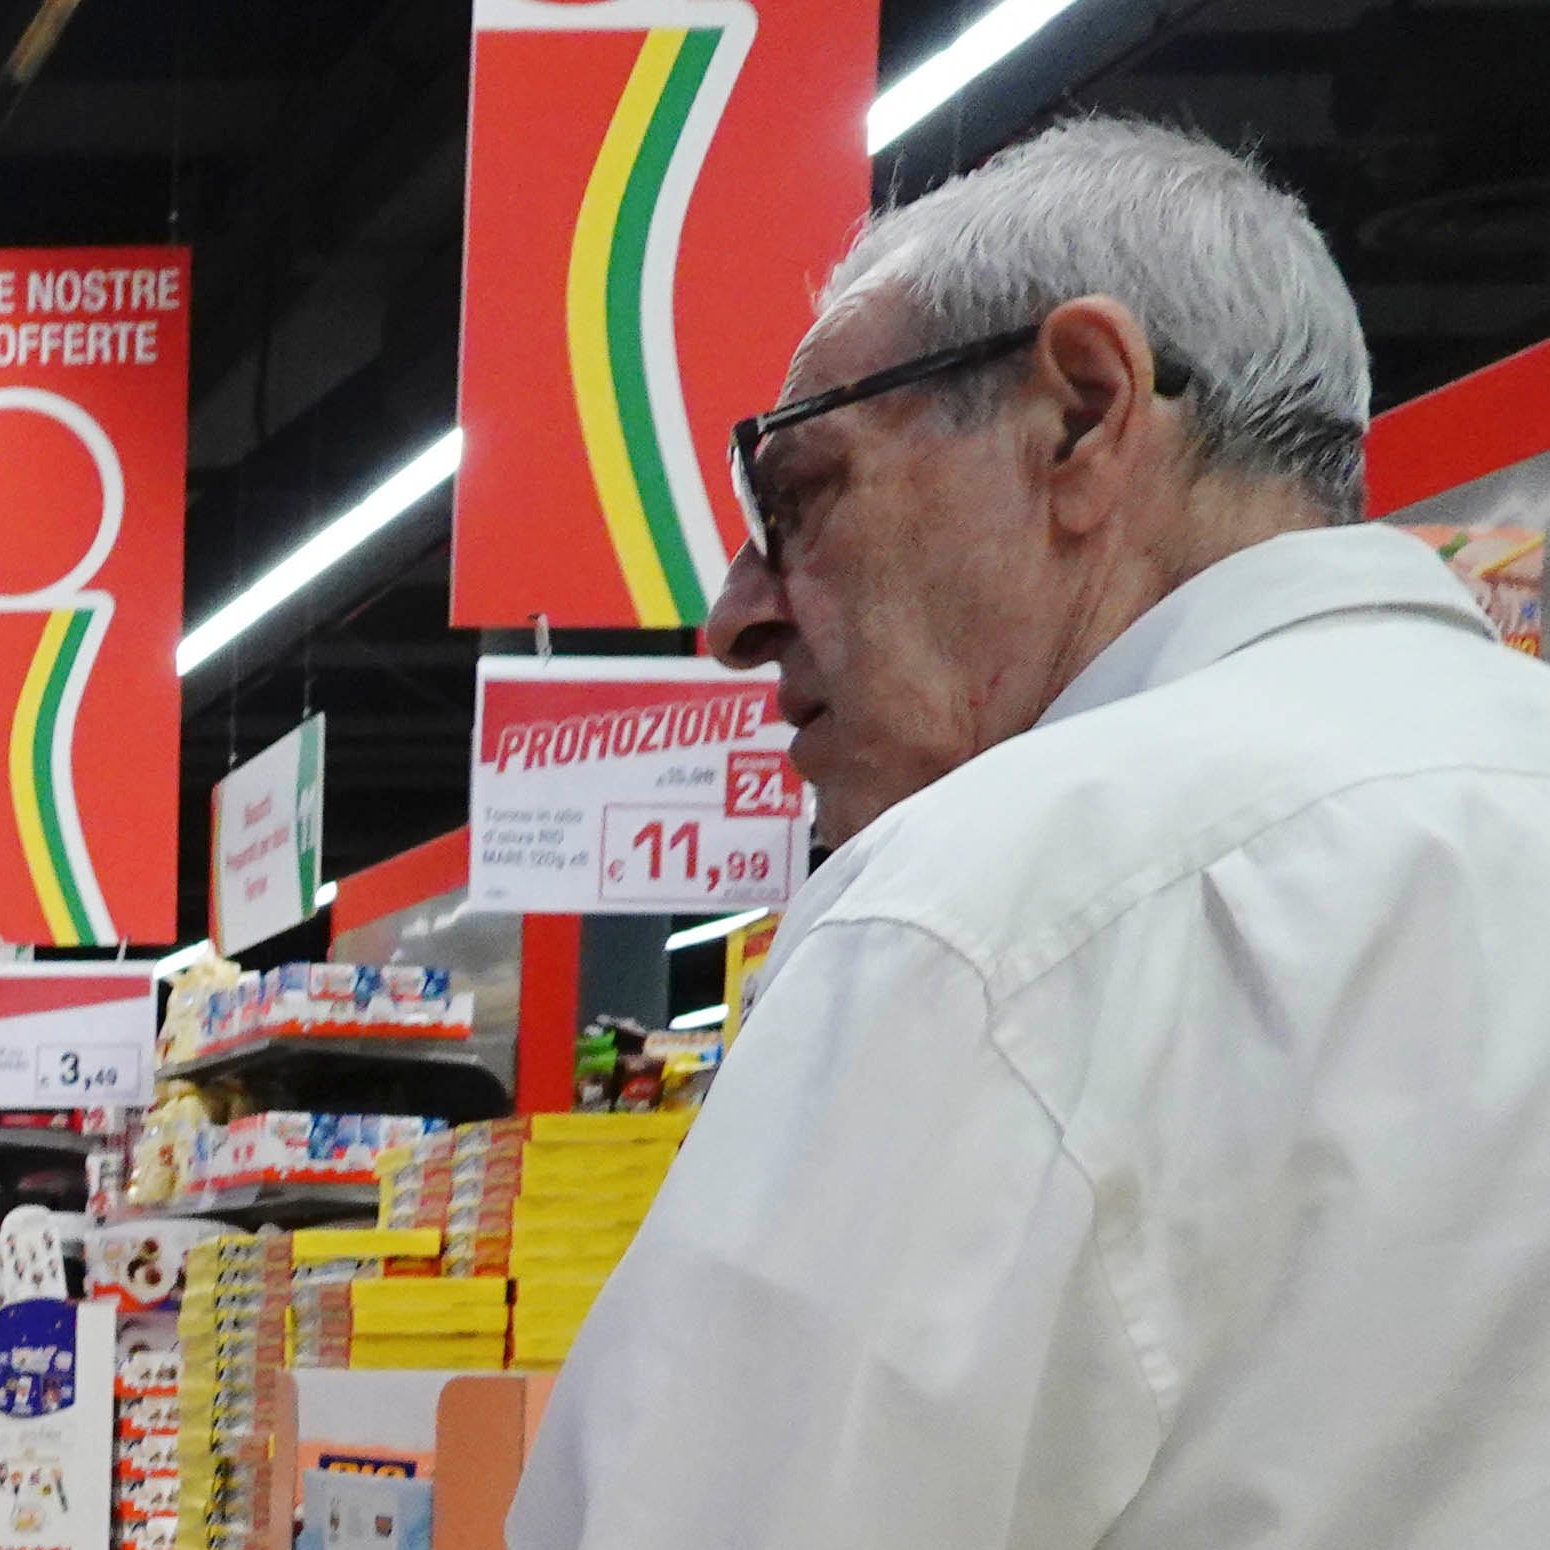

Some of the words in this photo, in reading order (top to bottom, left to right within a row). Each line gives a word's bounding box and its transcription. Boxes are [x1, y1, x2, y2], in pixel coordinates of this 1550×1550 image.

[26, 268, 180, 315] NOSTRE
[498, 695, 768, 774] PROMOZIONE
[607, 859, 625, 884] €
[633, 820, 770, 893] 11,99
